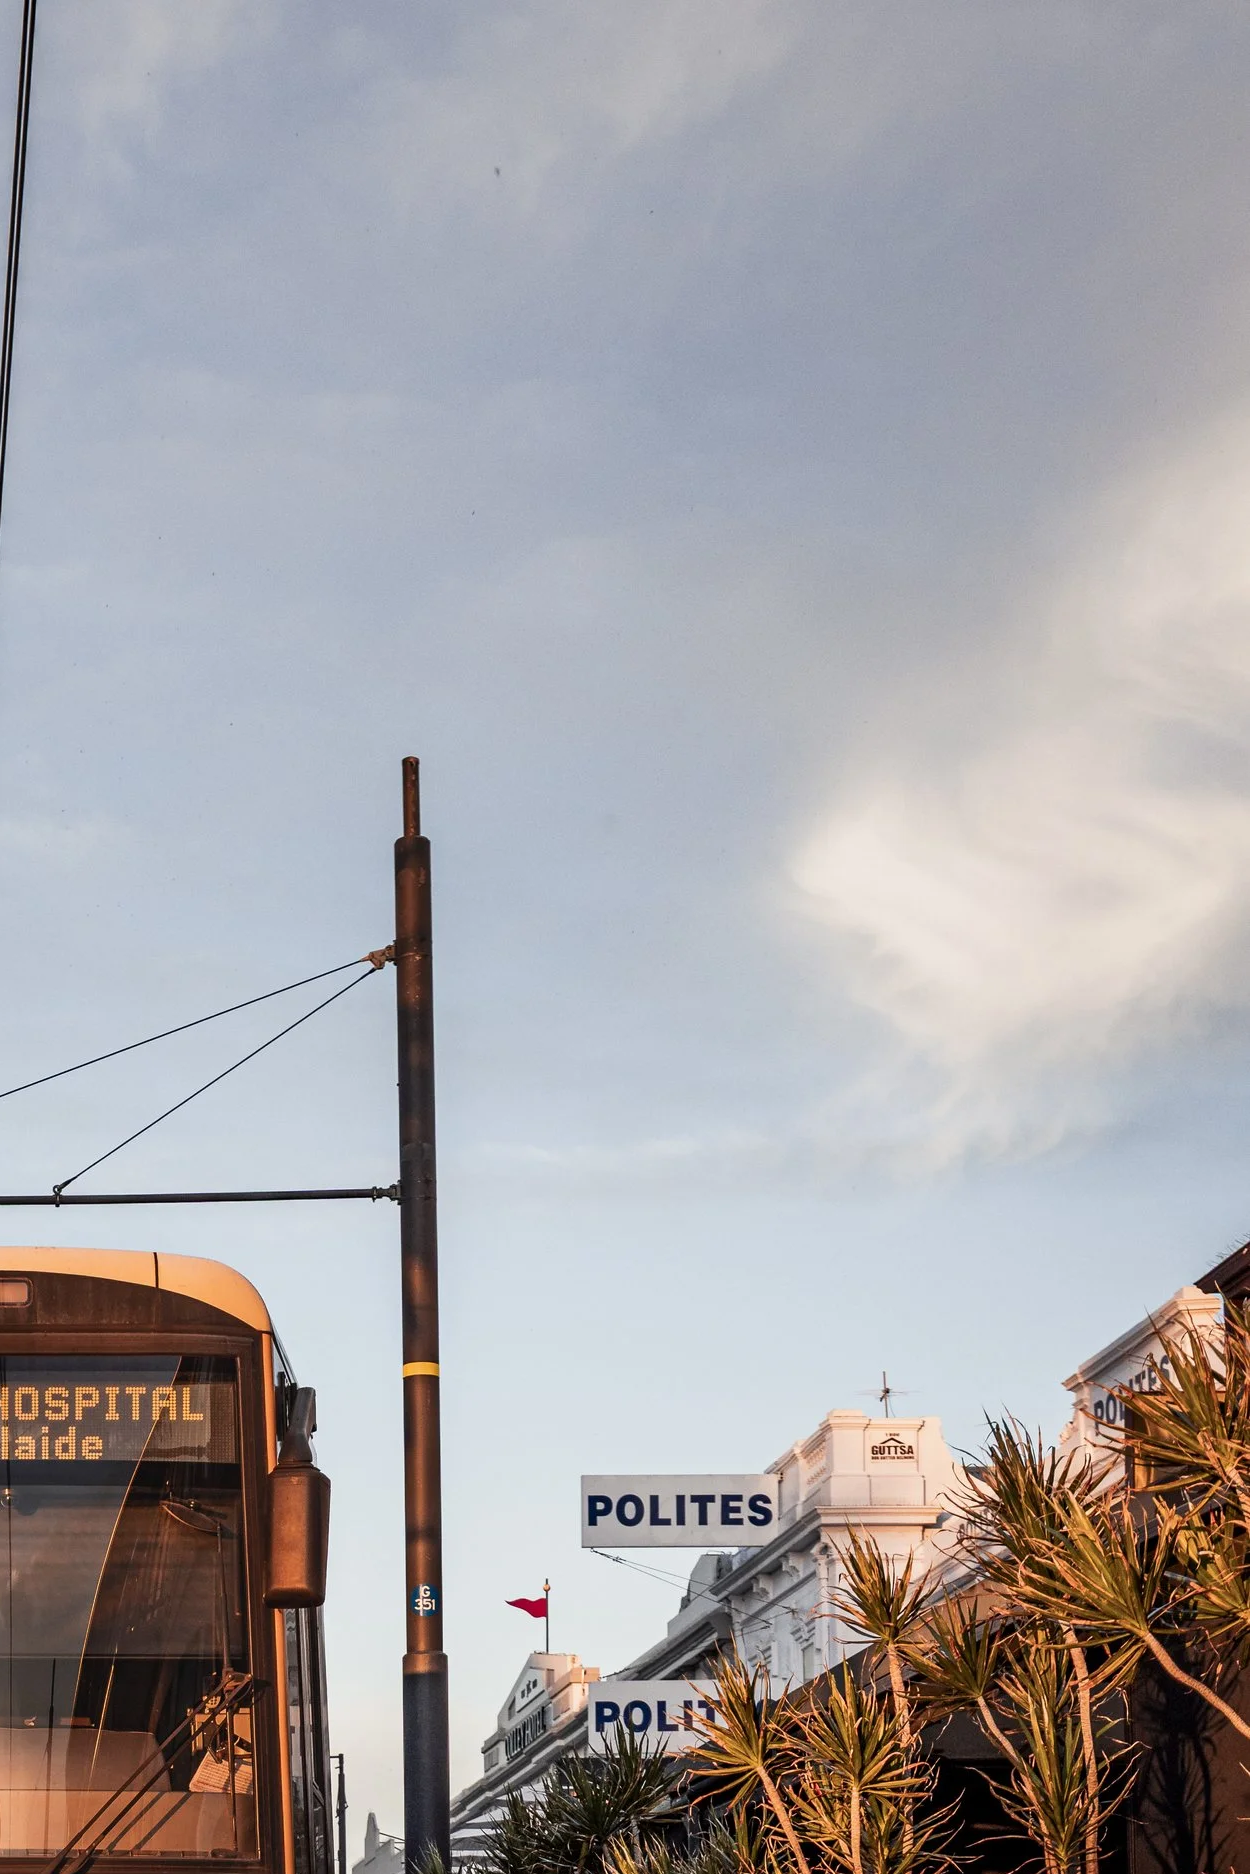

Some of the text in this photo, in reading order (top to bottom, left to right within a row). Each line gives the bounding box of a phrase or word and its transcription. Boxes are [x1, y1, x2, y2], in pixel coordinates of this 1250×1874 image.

[871, 1445, 914, 1455] GUTTSA
[588, 1493, 773, 1527] POLITES
[422, 1585, 431, 1598] G
[414, 1598, 436, 1610] 351
